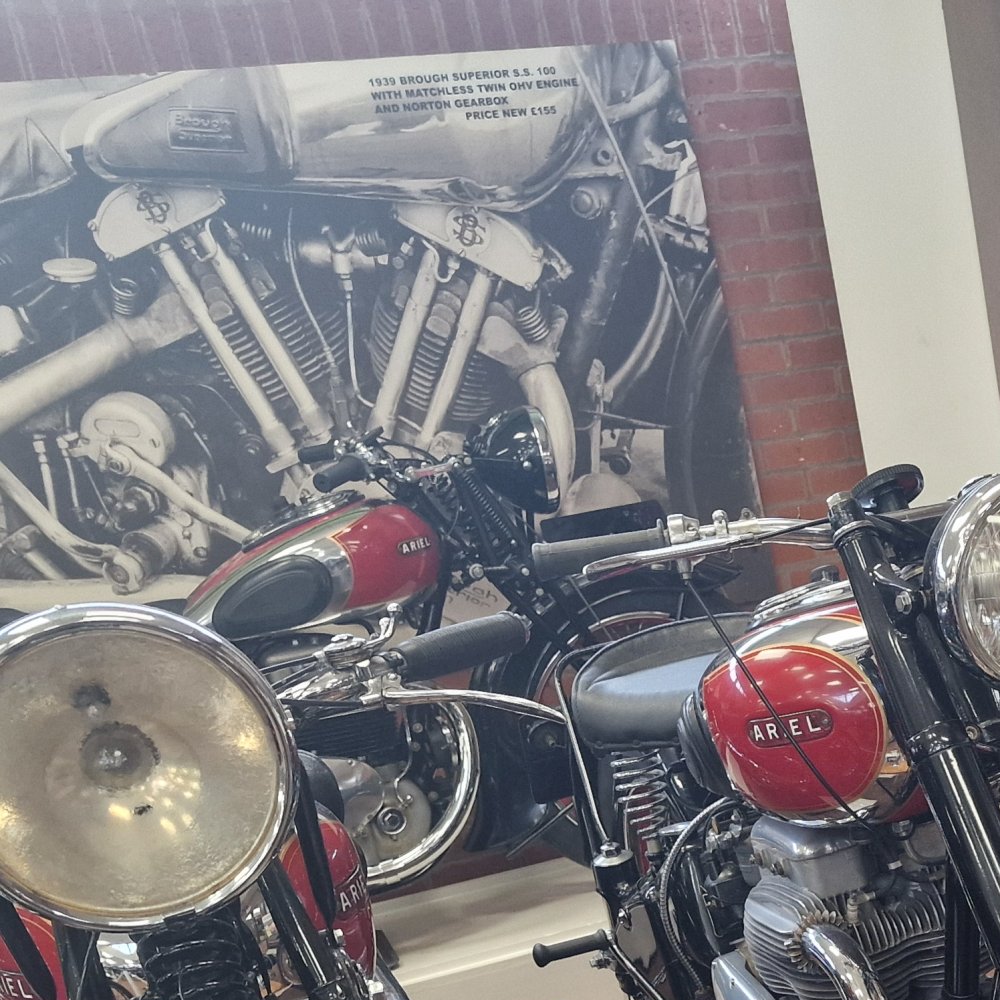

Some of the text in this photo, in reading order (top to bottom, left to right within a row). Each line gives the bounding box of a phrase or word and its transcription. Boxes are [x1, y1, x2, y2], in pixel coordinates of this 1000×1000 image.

[369, 66, 555, 87] 1939 BROUGH SUPERIOR S.S. 100
[371, 78, 579, 101] WITH MATCHLESS TWIN OHV ENGINE
[375, 96, 509, 114] AND NORTON GEARBOX
[466, 106, 557, 121] PRICE NEW £155
[402, 537, 430, 554] ARIEL
[753, 716, 821, 741] AREL
